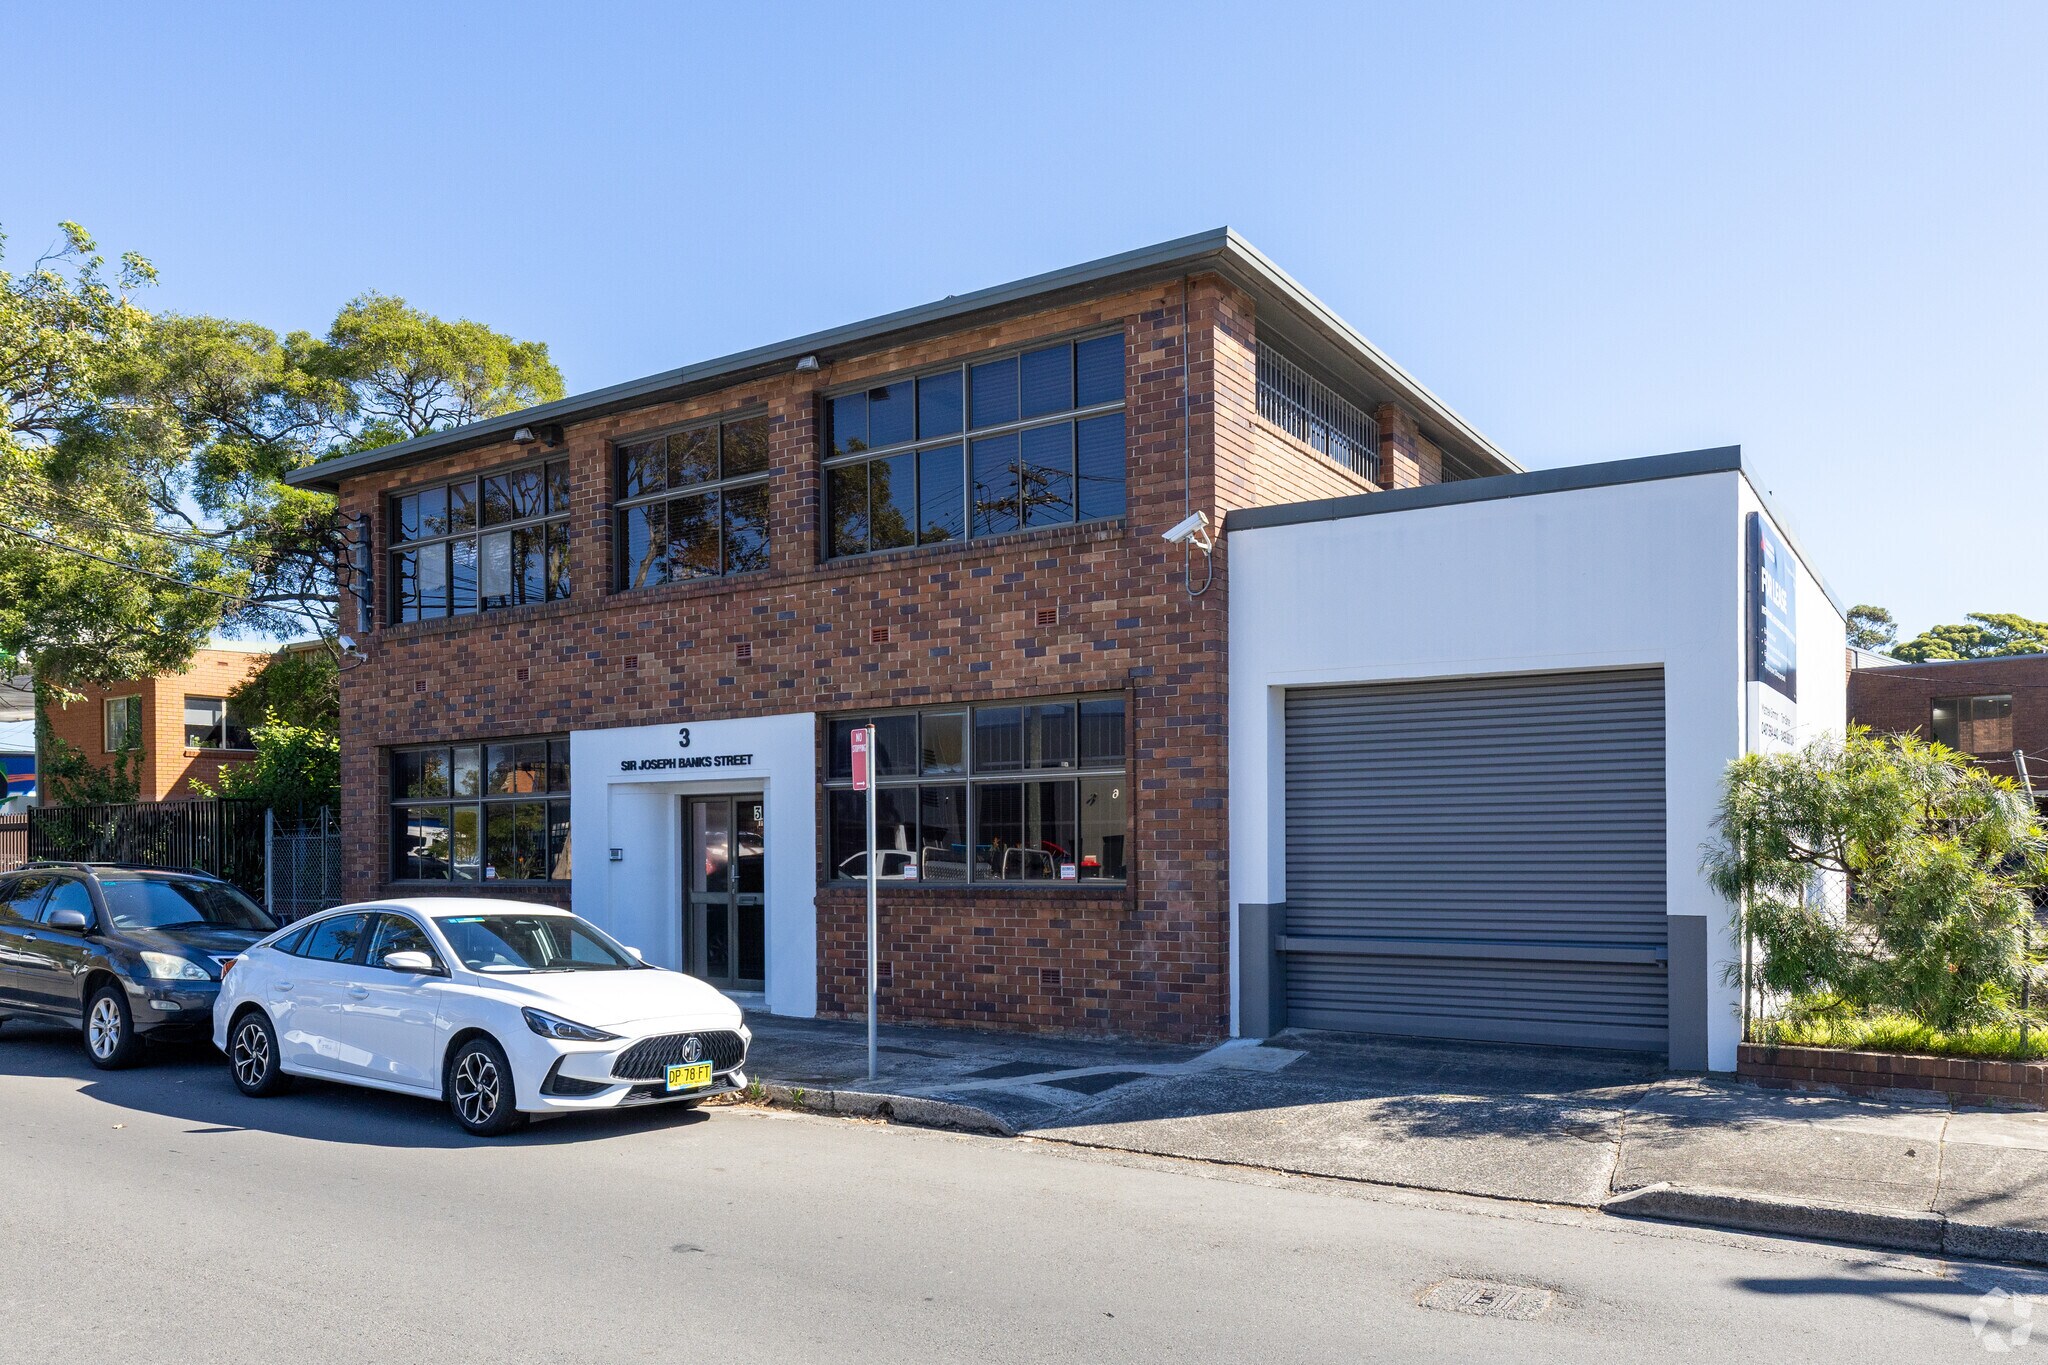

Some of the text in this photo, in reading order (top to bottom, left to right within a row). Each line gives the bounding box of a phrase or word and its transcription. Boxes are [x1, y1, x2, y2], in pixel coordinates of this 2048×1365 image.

[1773, 578, 1787, 615] LEASE
[679, 728, 690, 747] 3
[855, 733, 863, 742] NO
[621, 754, 753, 771] SIR JOSEPH BANKS STREET
